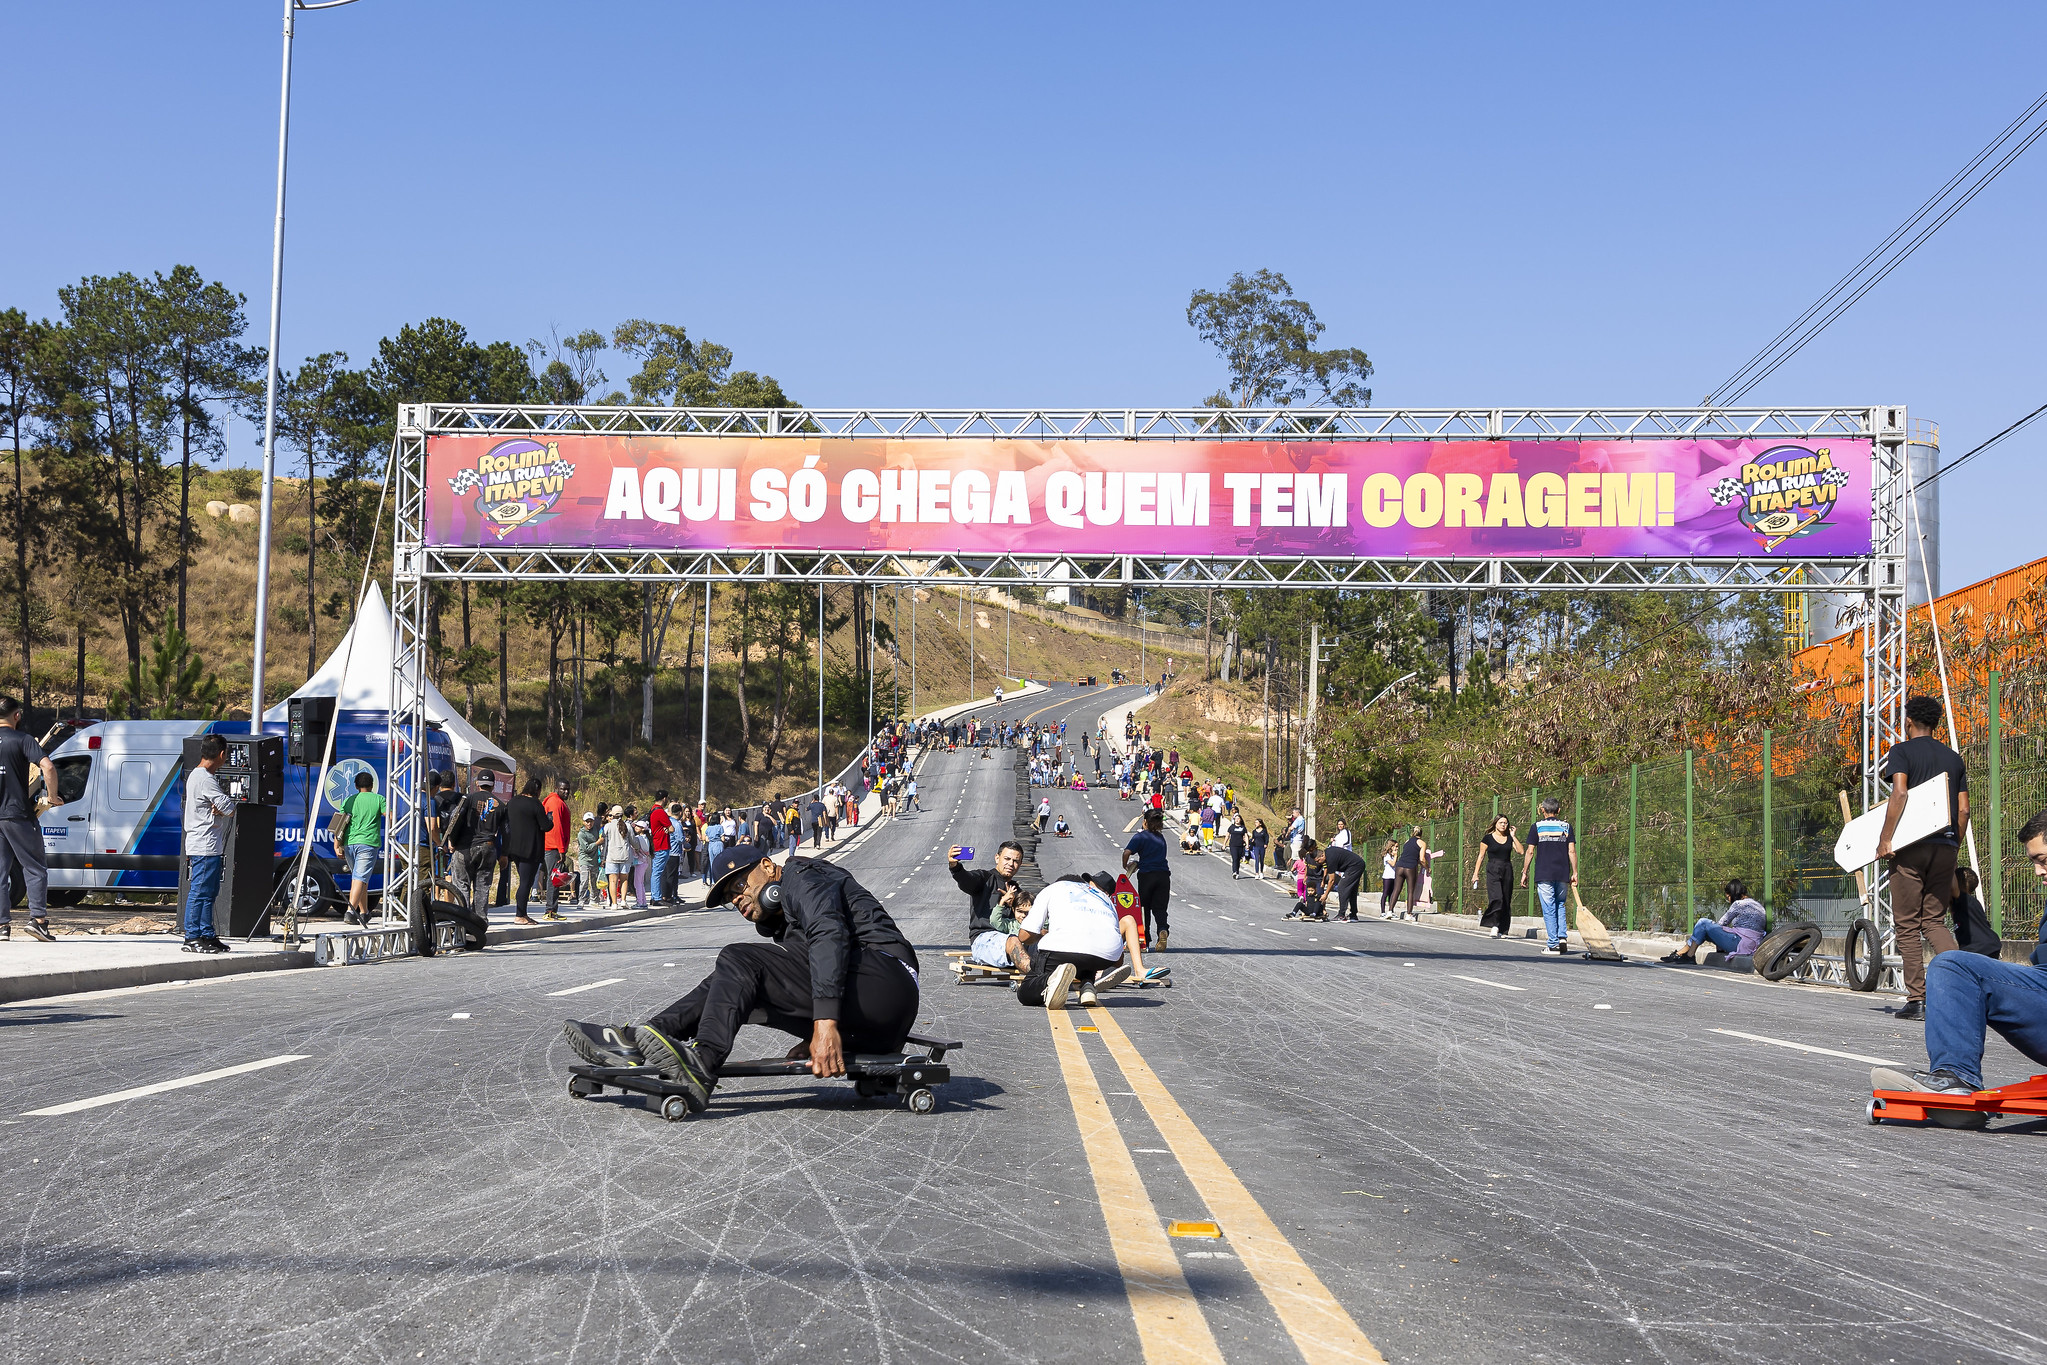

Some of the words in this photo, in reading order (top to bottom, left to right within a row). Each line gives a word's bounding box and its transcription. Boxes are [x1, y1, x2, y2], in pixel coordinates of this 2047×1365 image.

[484, 475, 564, 503] ITAPEVI
[488, 471, 512, 486] NA
[514, 465, 546, 482] RUA
[1753, 479, 1780, 495] NA
[1781, 473, 1817, 491] RUA
[603, 466, 737, 525] AQUI
[750, 455, 828, 523] SÓ
[840, 468, 1032, 524] CHEGA
[1045, 470, 1211, 530] QUEM
[1223, 472, 1348, 528] TEM
[1361, 472, 1676, 528] CORAGEM!
[1749, 484, 1837, 514] ITAPEVI
